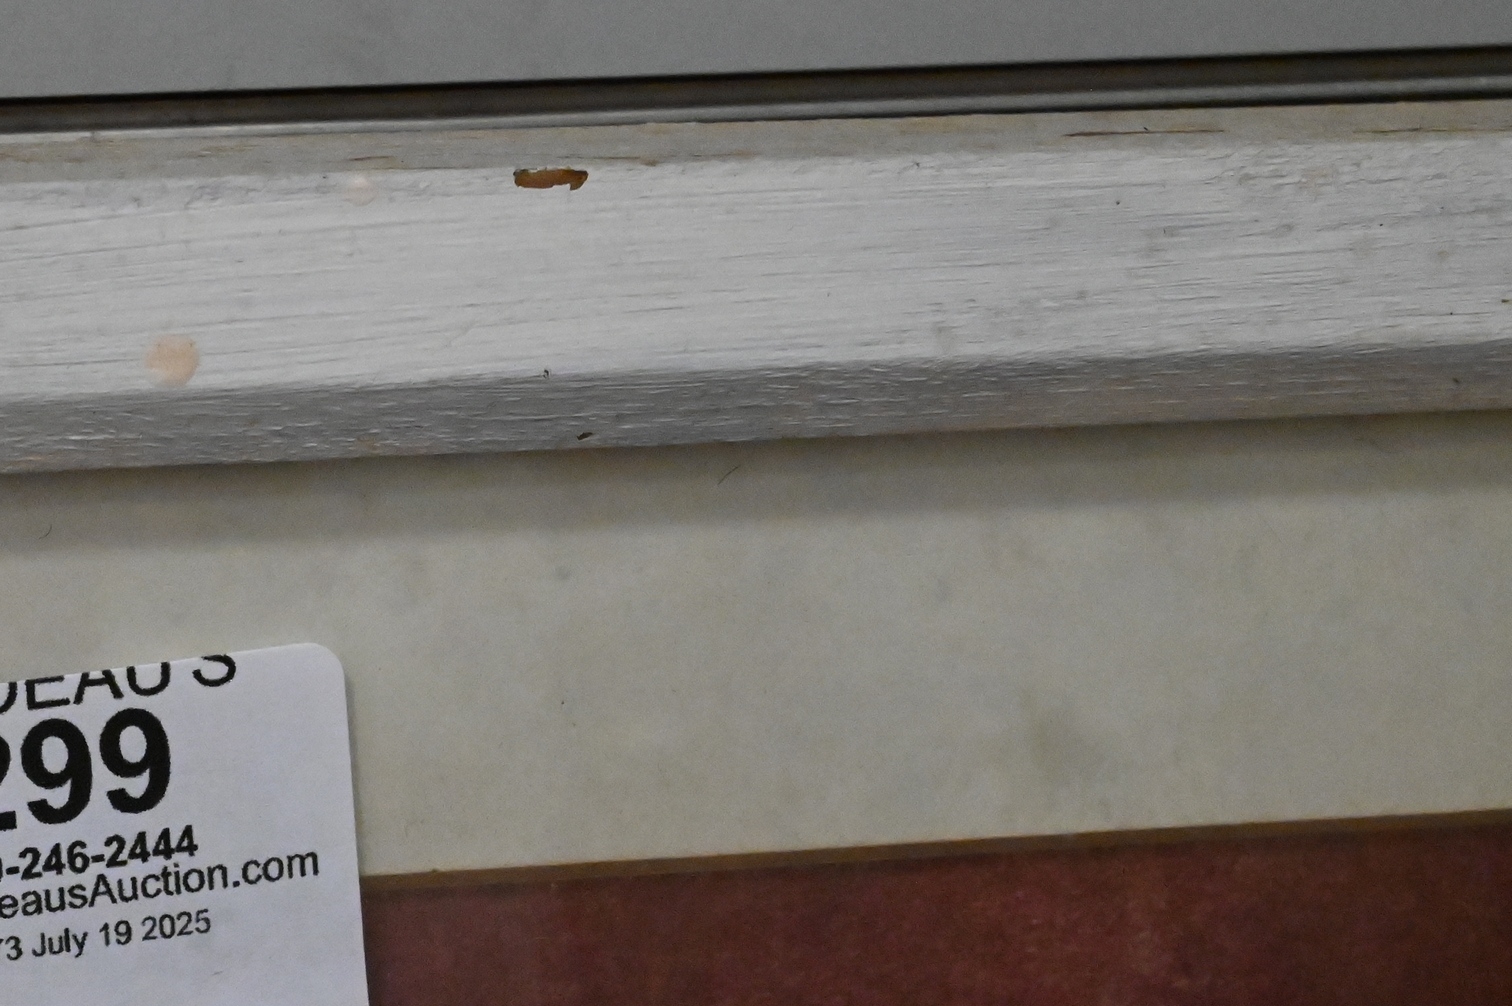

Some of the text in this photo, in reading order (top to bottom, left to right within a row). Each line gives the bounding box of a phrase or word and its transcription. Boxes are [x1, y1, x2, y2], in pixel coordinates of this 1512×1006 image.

[31, 926, 89, 959] July
[98, 919, 133, 948] 19
[140, 908, 212, 942] 2025
